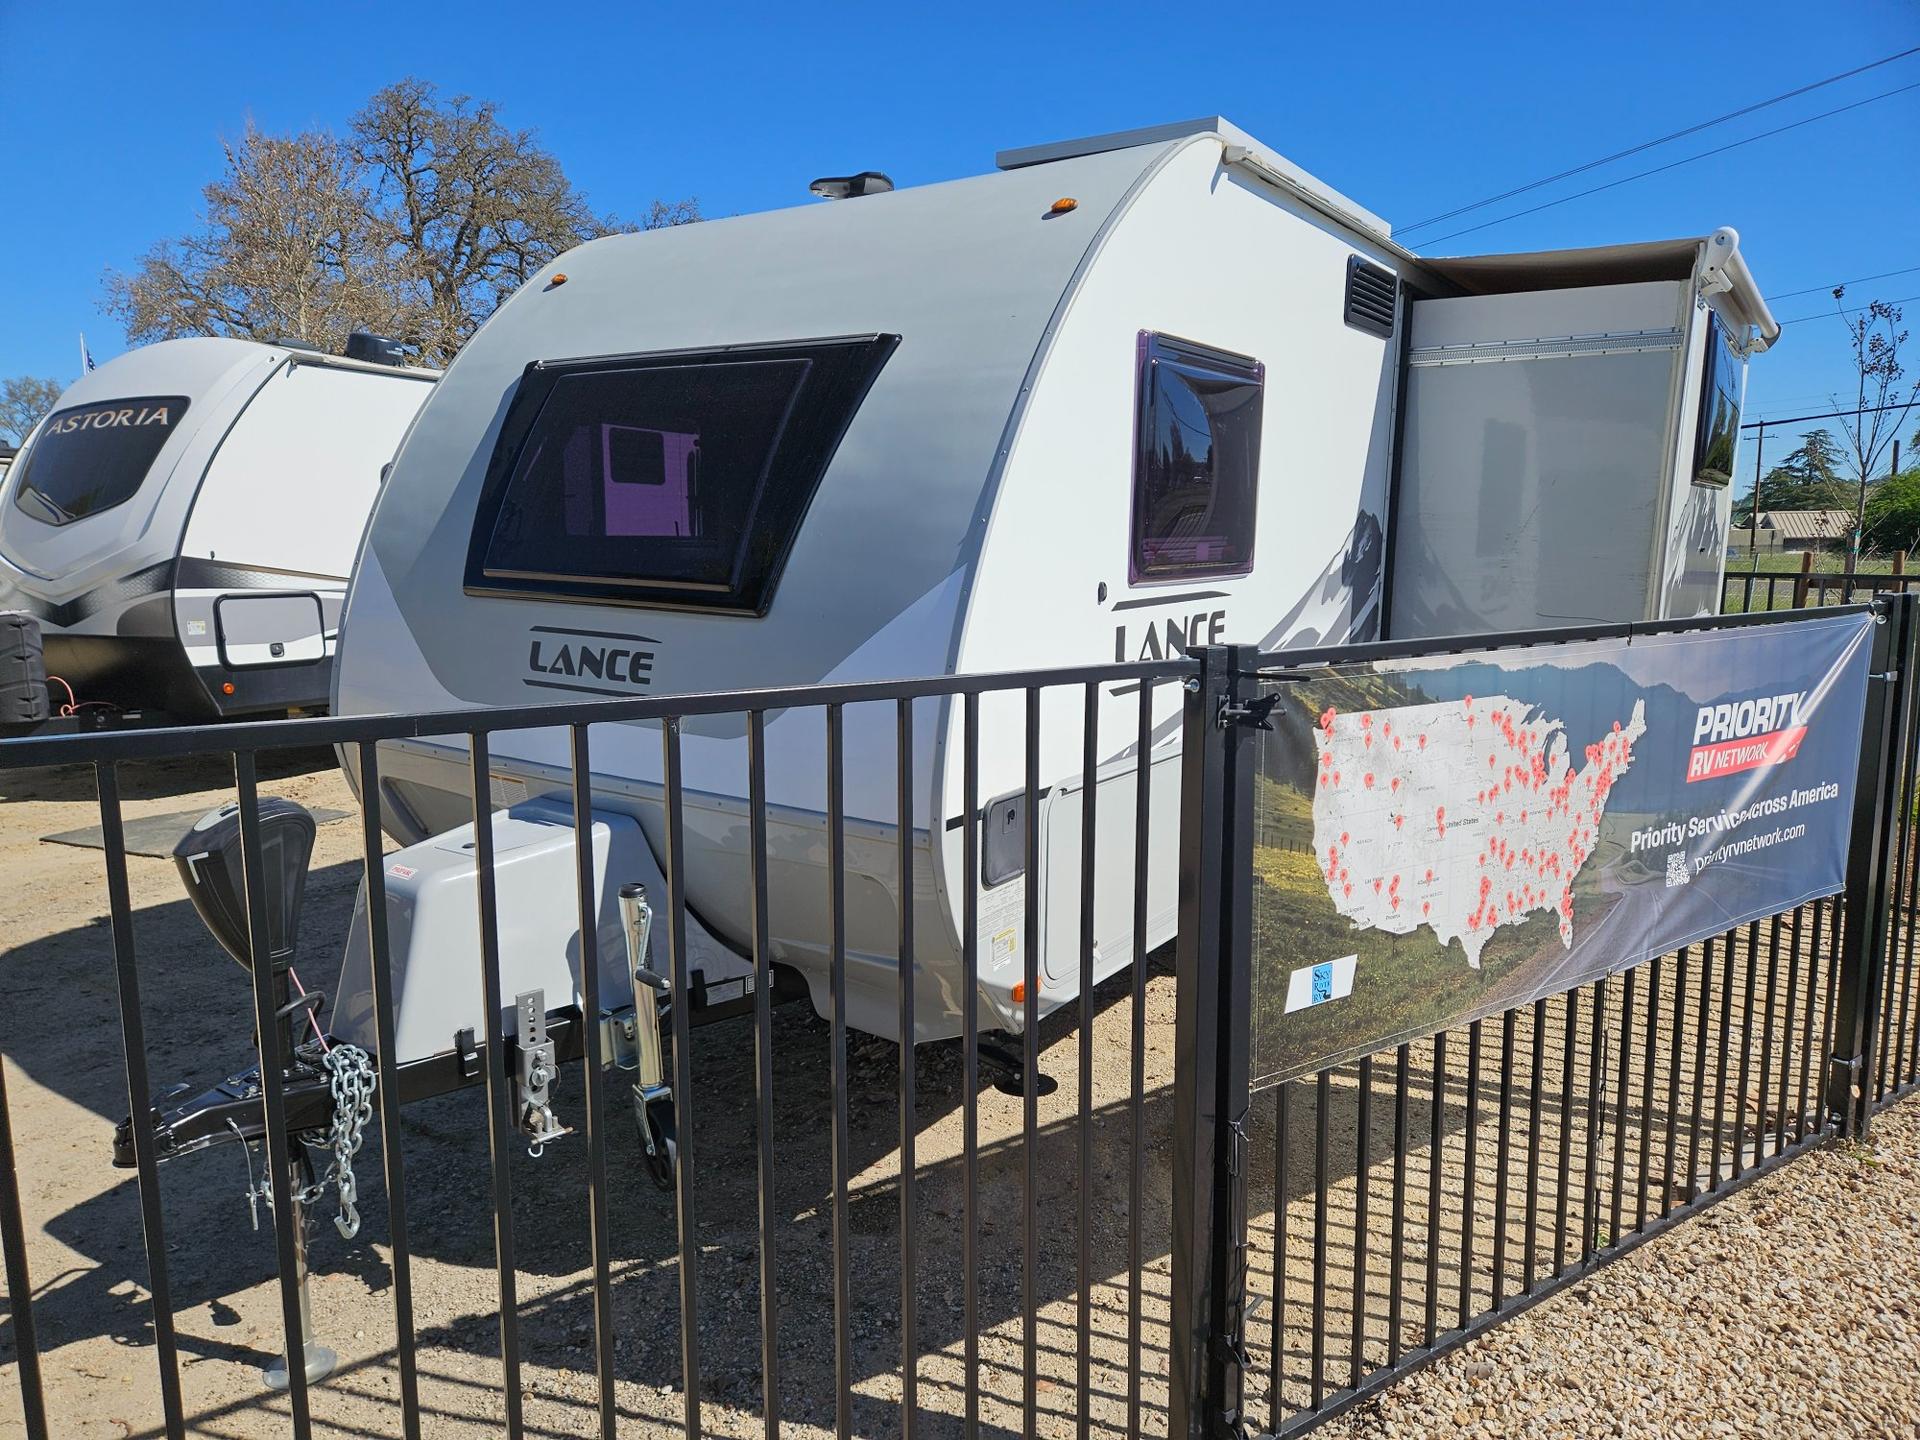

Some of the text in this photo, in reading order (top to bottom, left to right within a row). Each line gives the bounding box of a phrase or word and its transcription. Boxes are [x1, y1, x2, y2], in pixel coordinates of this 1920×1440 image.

[45, 407, 168, 437] ASTORIA
[529, 641, 655, 685] LANCE
[1693, 691, 1807, 745] PRIORITY
[1690, 742, 1769, 777] RV NETWORK
[1630, 823, 1687, 853] Priority
[1788, 781, 1839, 809] America
